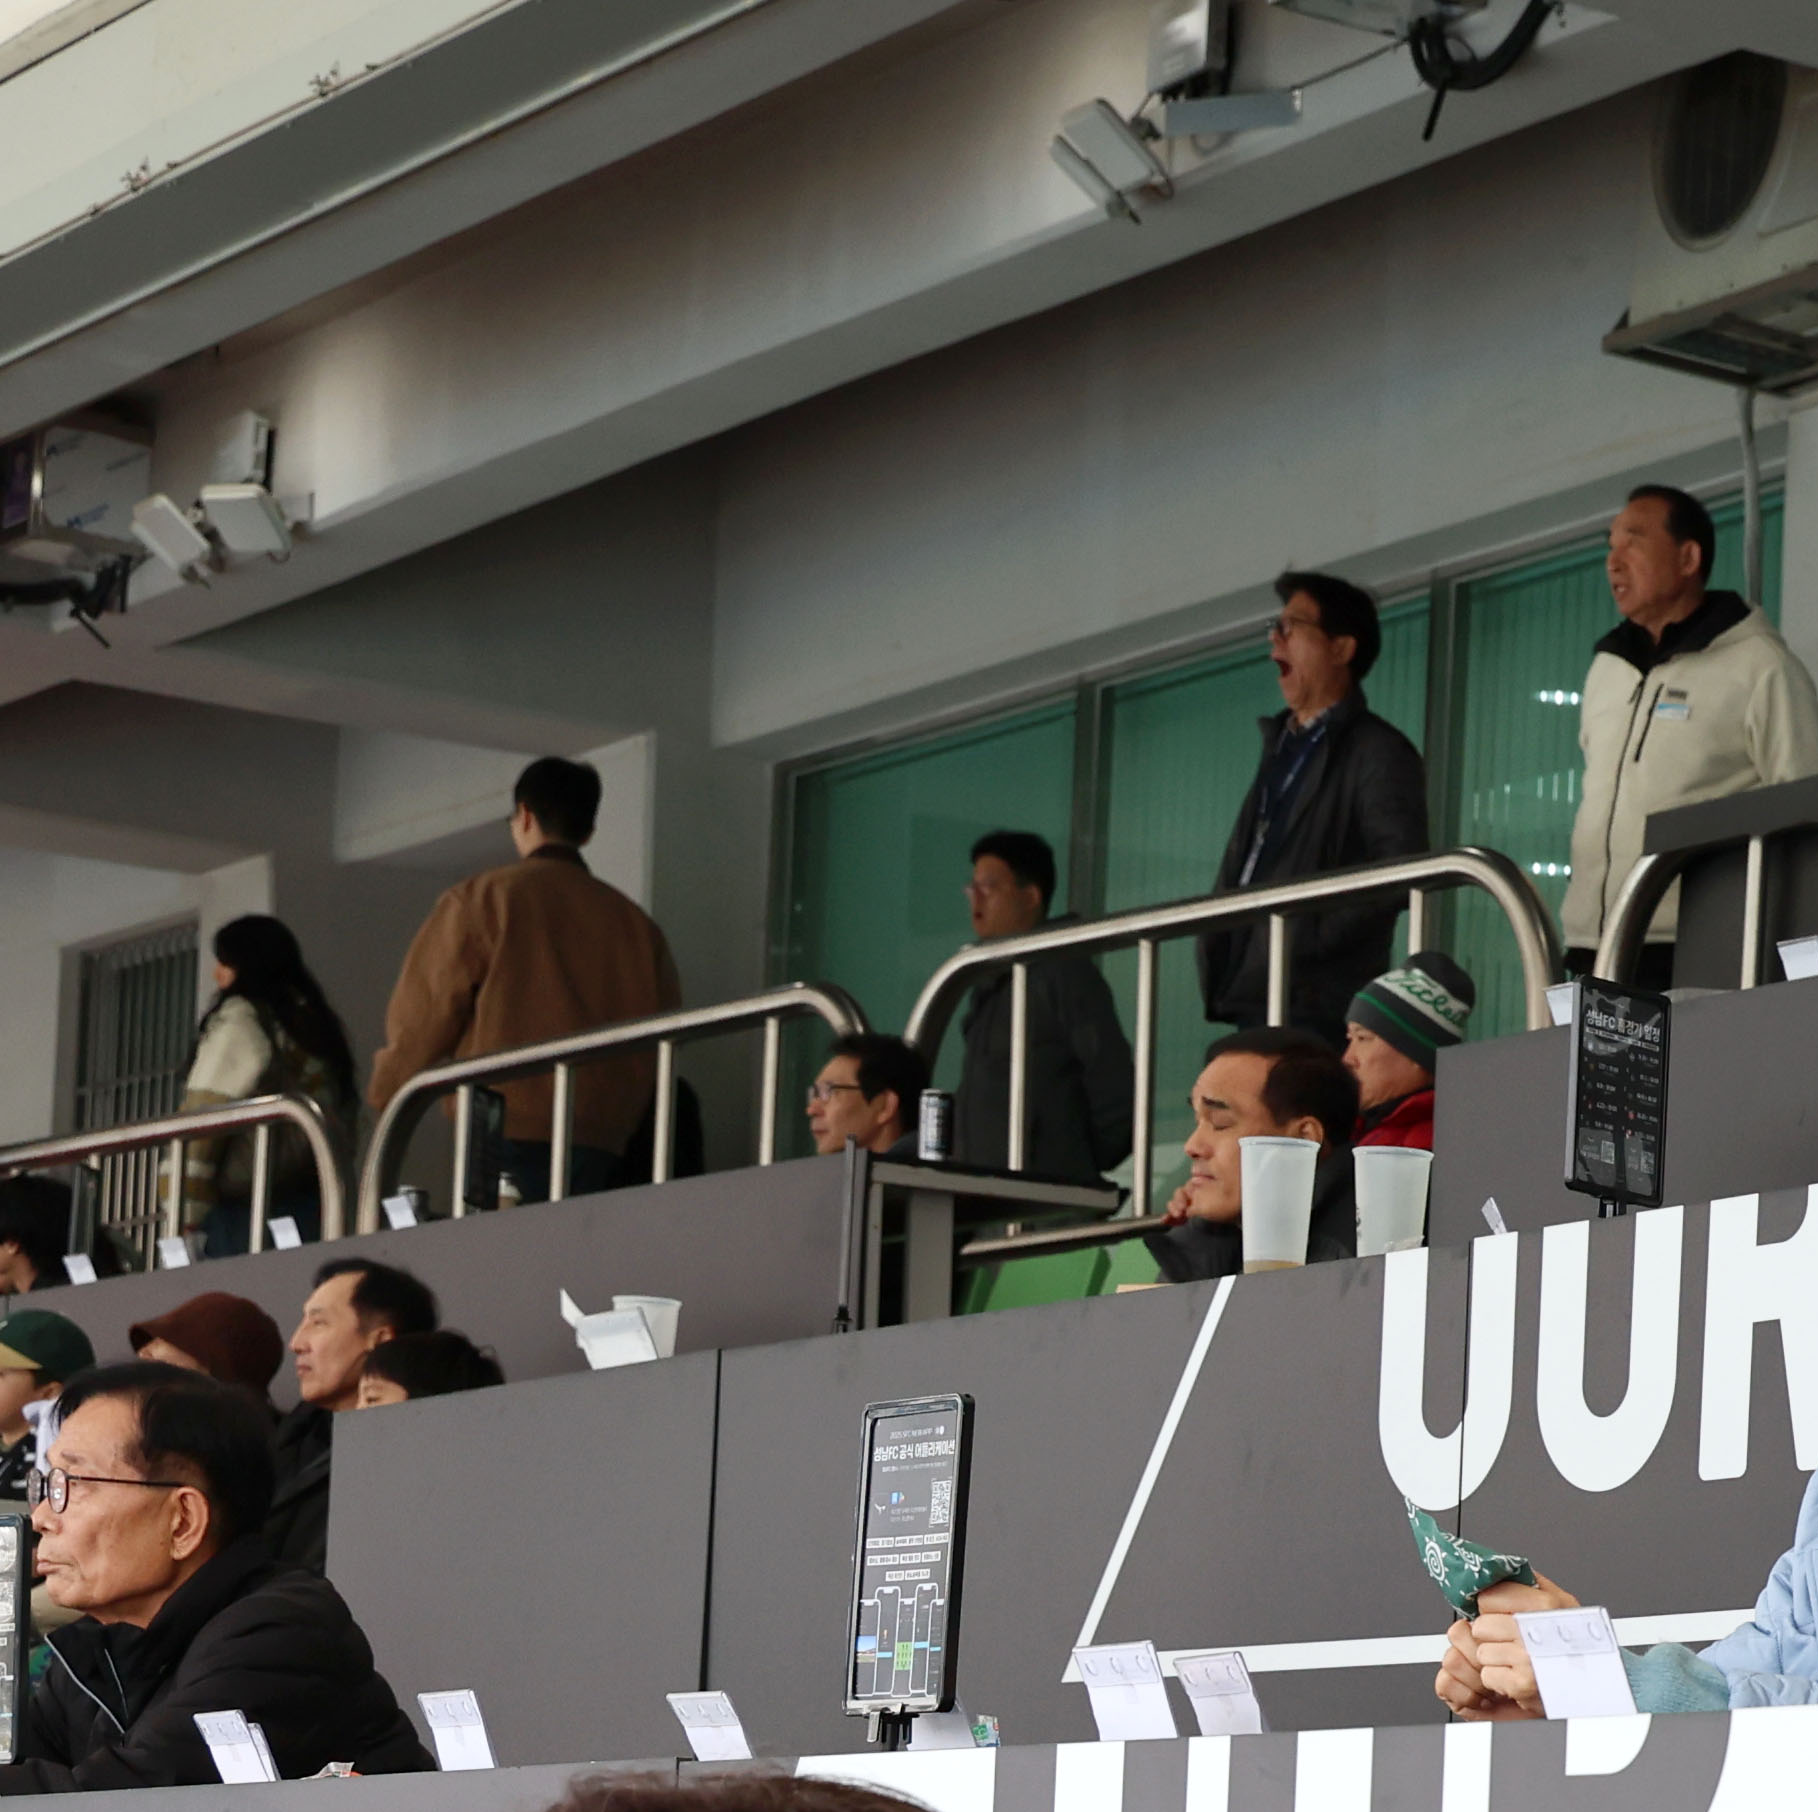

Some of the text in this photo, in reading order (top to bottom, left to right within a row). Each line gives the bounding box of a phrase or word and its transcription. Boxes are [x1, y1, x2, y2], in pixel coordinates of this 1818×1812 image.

[1586, 1008, 1616, 1029] 성남FC
[873, 1445, 899, 1462] 성남FC
[899, 1443, 914, 1460] 공식
